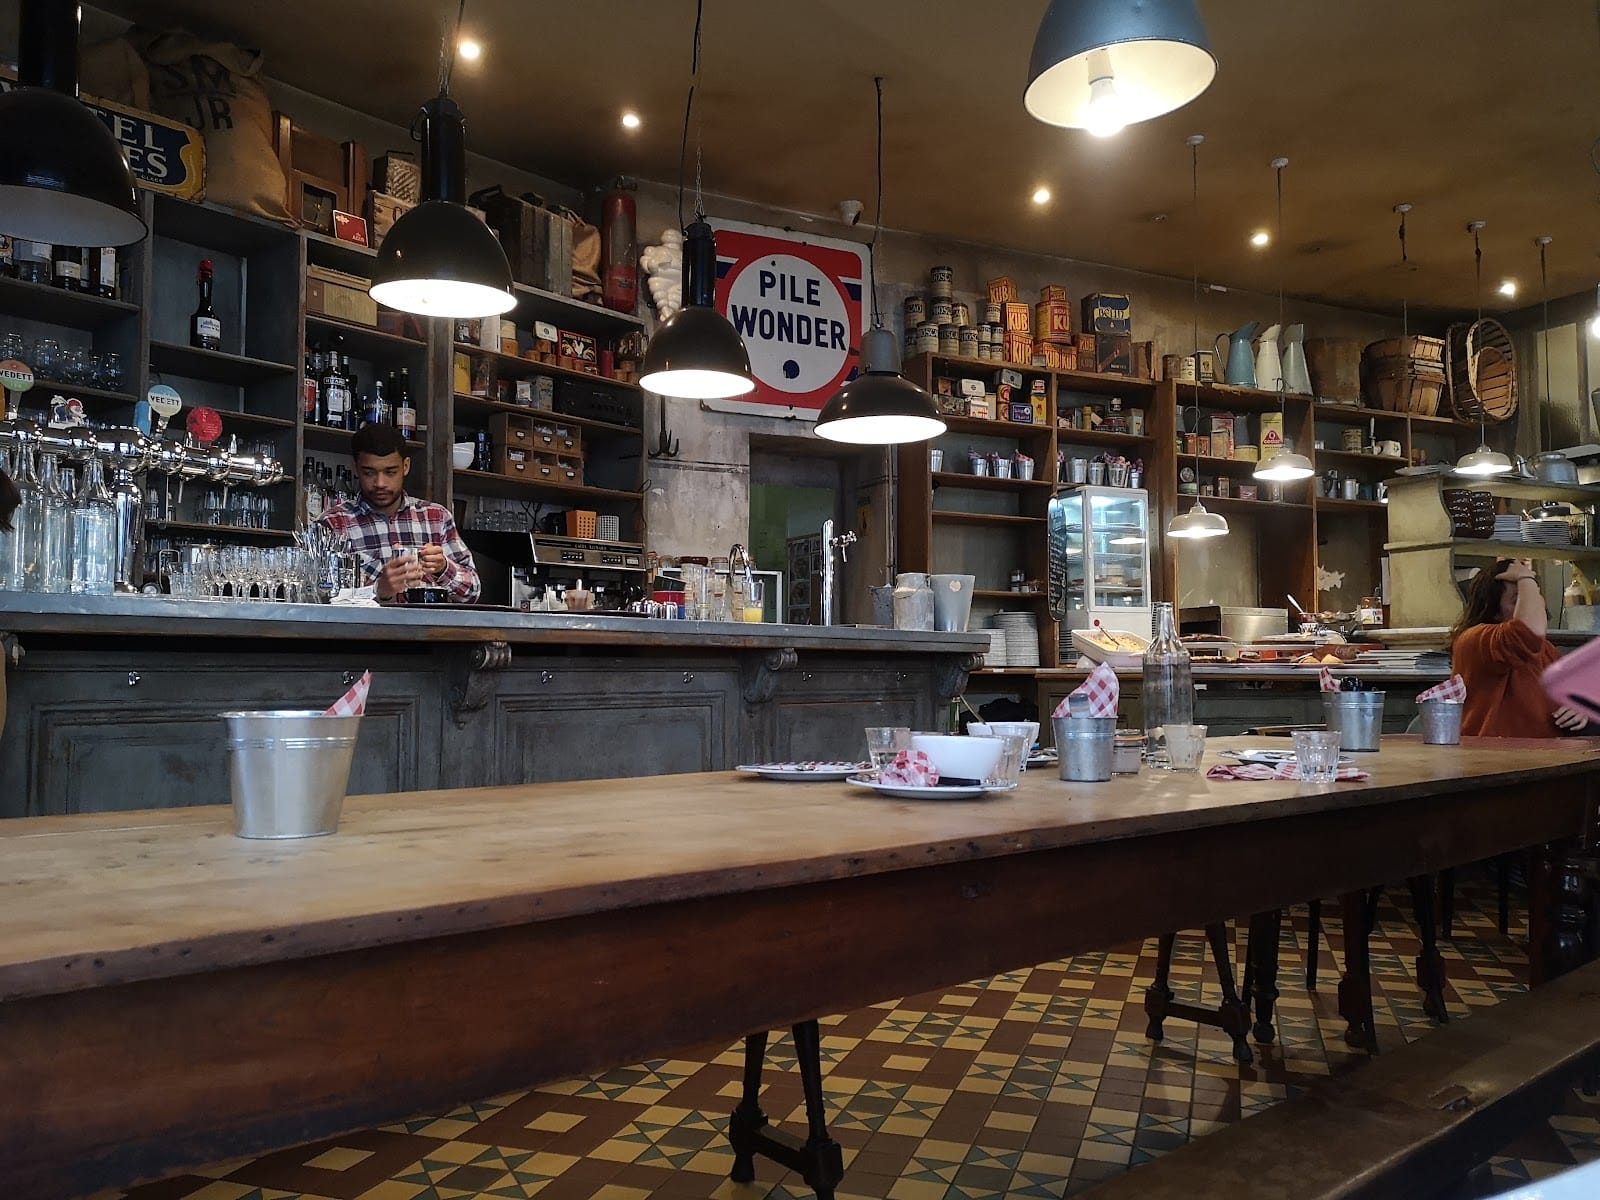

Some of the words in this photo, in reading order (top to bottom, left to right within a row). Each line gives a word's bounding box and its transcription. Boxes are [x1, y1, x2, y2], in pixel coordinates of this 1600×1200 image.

[185, 96, 233, 130] JR
[759, 270, 821, 306] PILE
[990, 286, 1009, 302] KUB
[731, 304, 847, 351] WONDER
[1008, 312, 1027, 331] KUB
[1013, 341, 1031, 364] KUB
[1079, 339, 1094, 352] KUB
[1045, 350, 1060, 368] KUB
[1062, 353, 1077, 370] KUB
[0, 370, 33, 381] VEDETT
[150, 395, 179, 406] VEDETT
